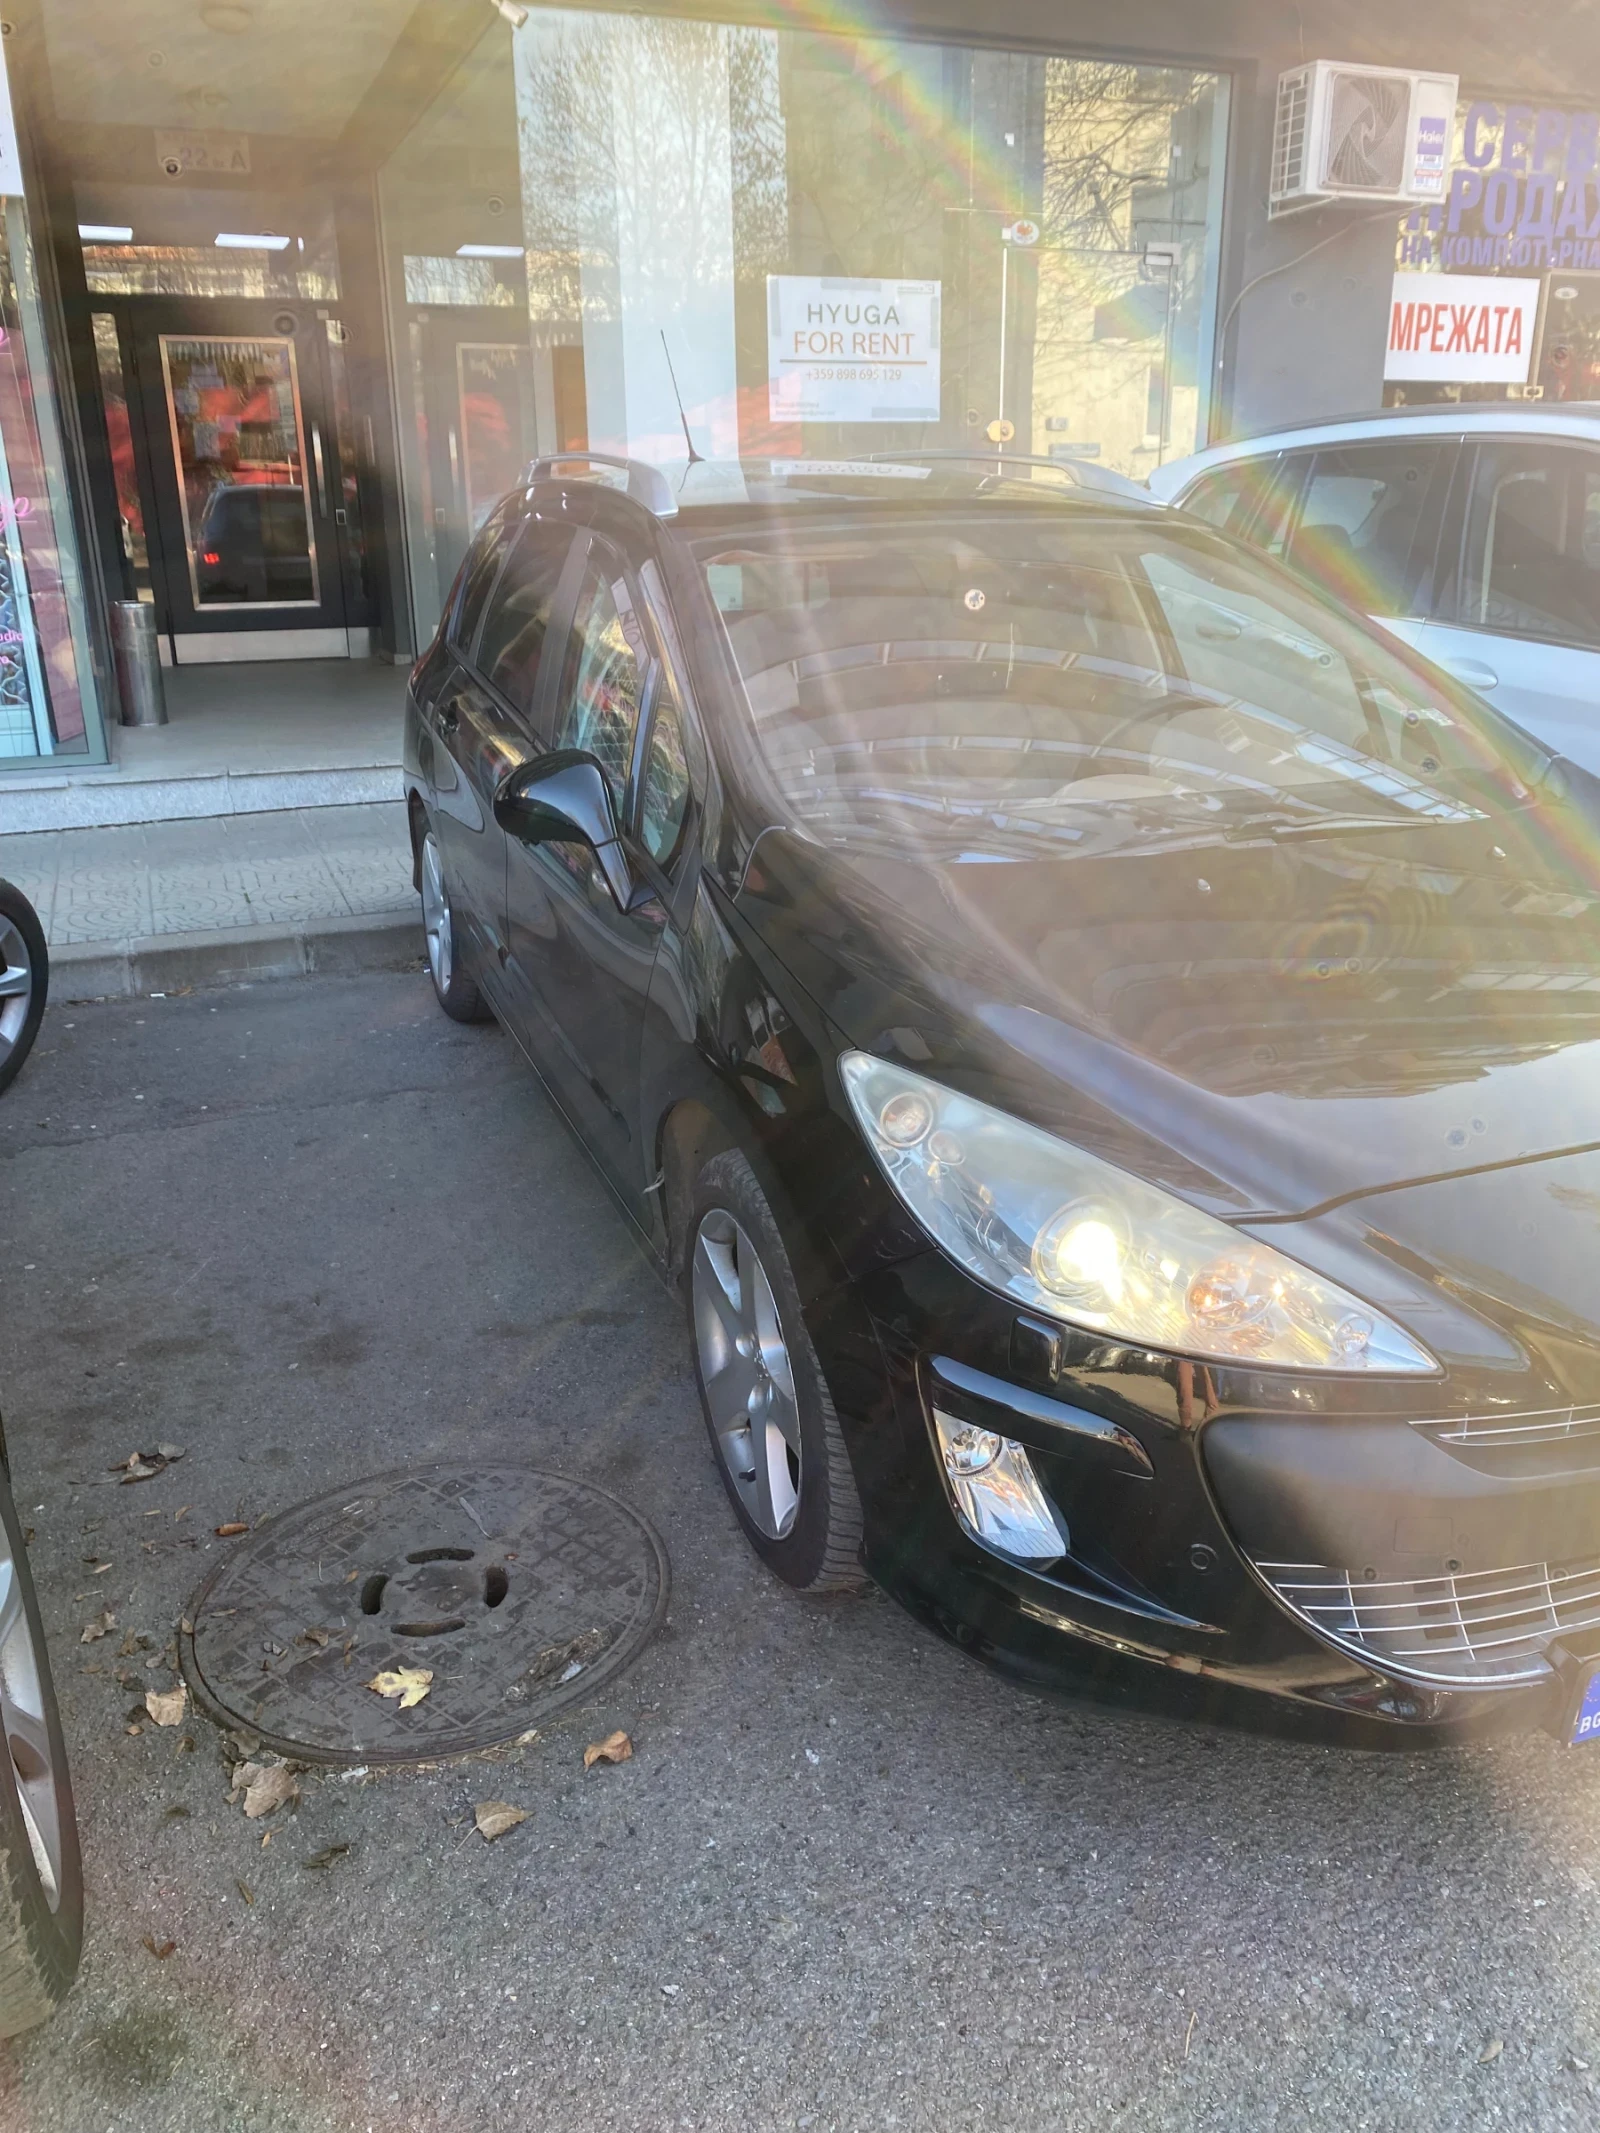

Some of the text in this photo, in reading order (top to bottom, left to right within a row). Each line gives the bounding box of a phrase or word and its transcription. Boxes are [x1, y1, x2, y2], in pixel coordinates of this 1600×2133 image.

[1401, 235, 1433, 264] НА
[806, 303, 901, 326] HYUGA
[1389, 302, 1523, 355] МРЕЖАТА
[793, 331, 916, 355] FOR RENT
[805, 367, 902, 380] +359 898 695 129
